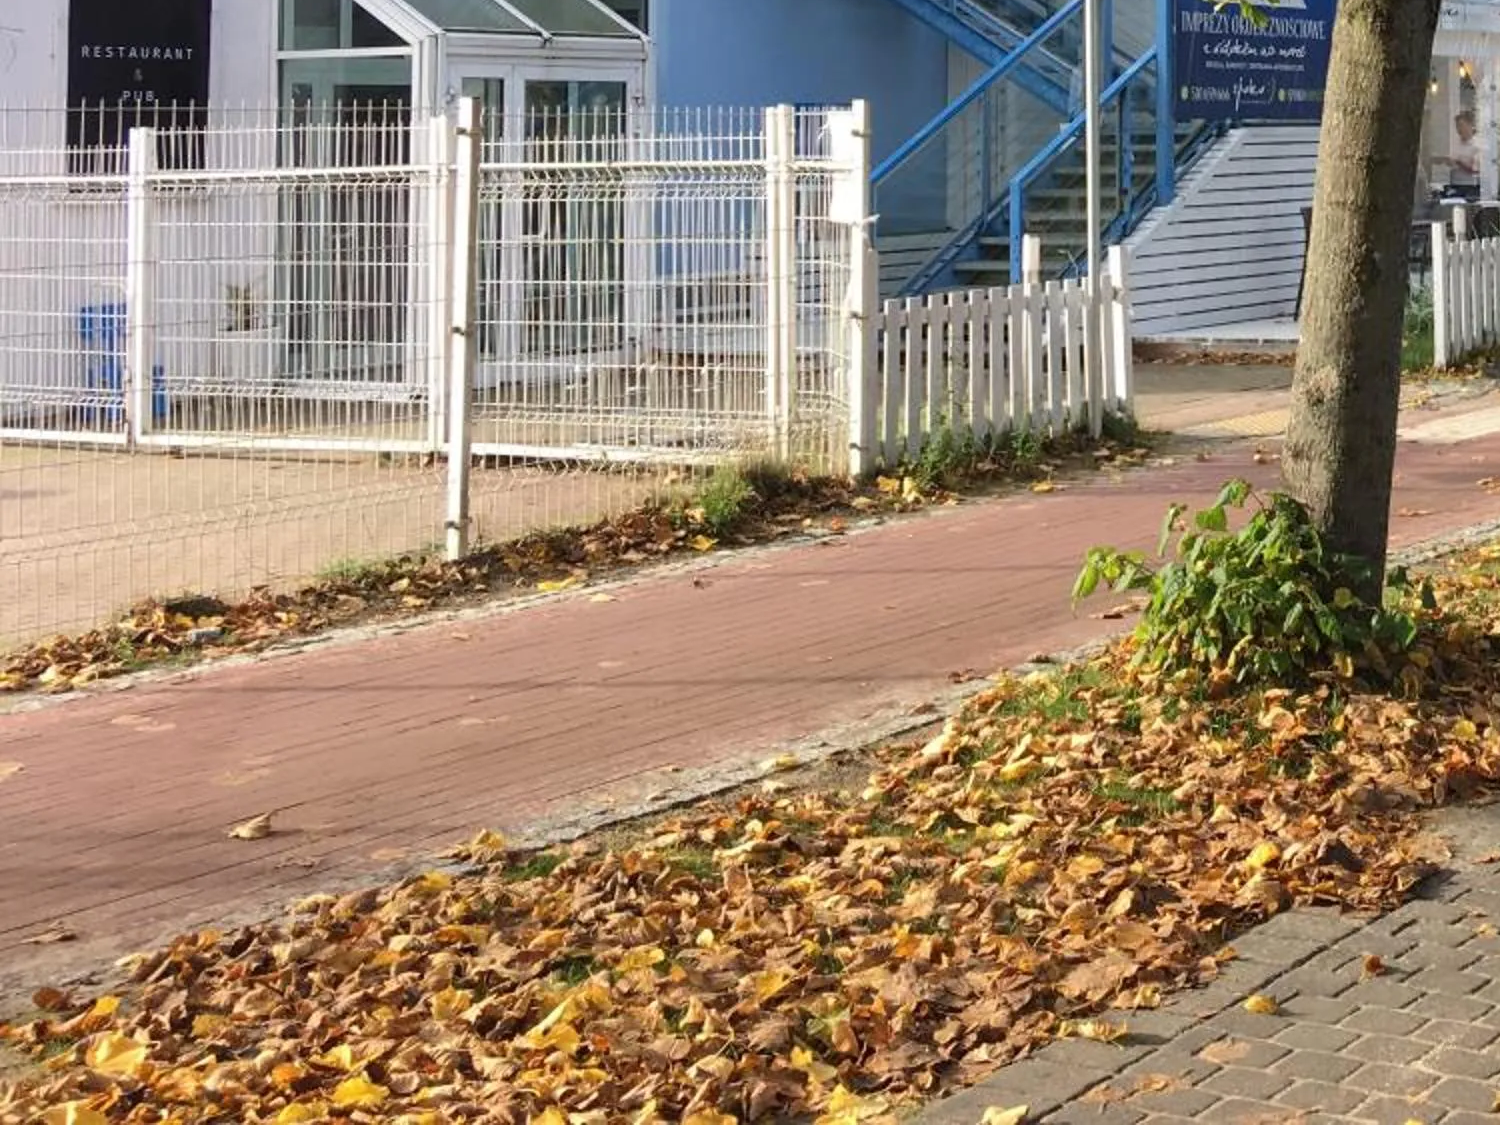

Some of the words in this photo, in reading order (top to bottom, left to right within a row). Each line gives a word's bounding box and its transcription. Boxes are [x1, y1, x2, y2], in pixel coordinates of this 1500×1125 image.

[1181, 10, 1229, 35] IMPREZY
[81, 45, 193, 60] RESTAURANT
[122, 90, 155, 102] PUB
